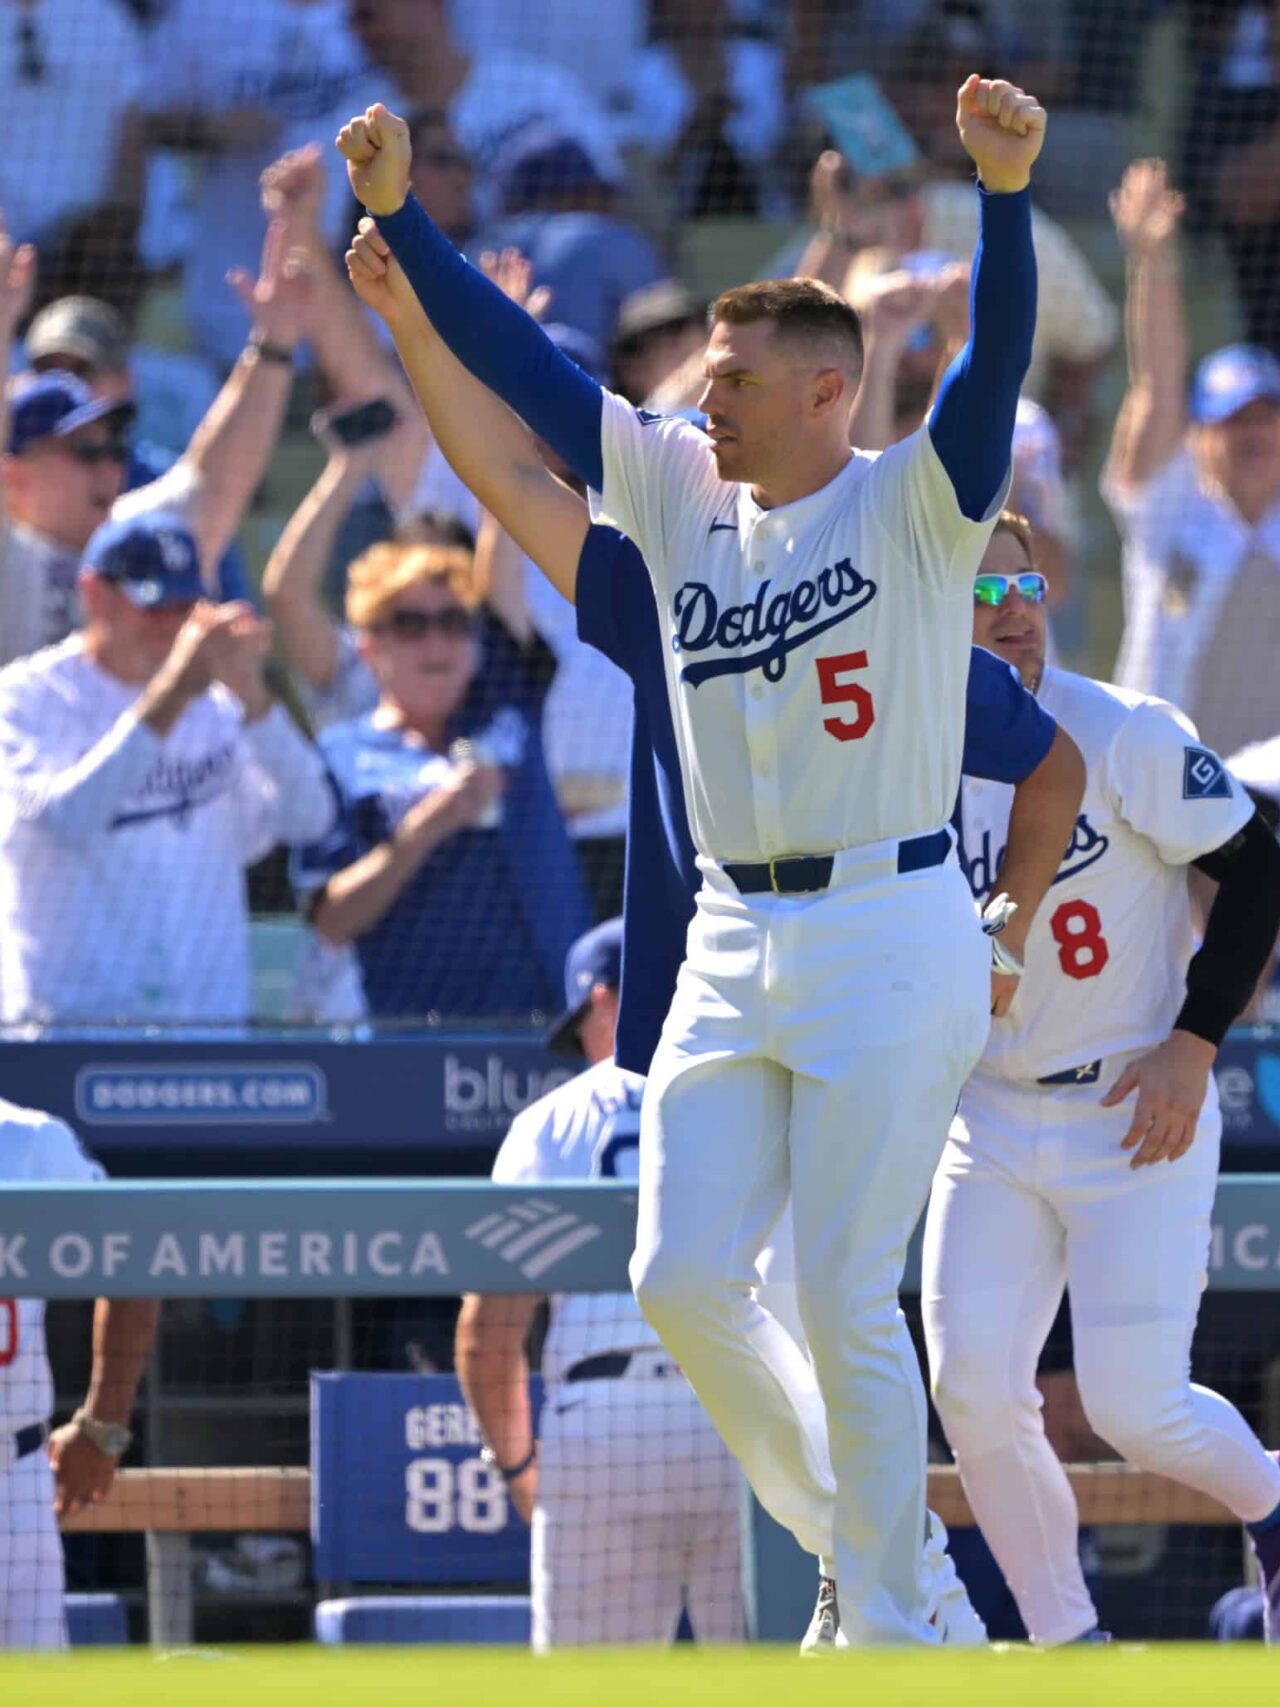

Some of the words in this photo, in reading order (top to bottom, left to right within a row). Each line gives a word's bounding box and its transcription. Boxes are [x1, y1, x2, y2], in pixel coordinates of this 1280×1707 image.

[673, 558, 877, 690] Dodgers
[815, 650, 875, 742] 5
[1050, 898, 1109, 980] 8
[49, 1233, 132, 1278] OF
[148, 1231, 449, 1277] AMERICA
[405, 1458, 509, 1533] 88
